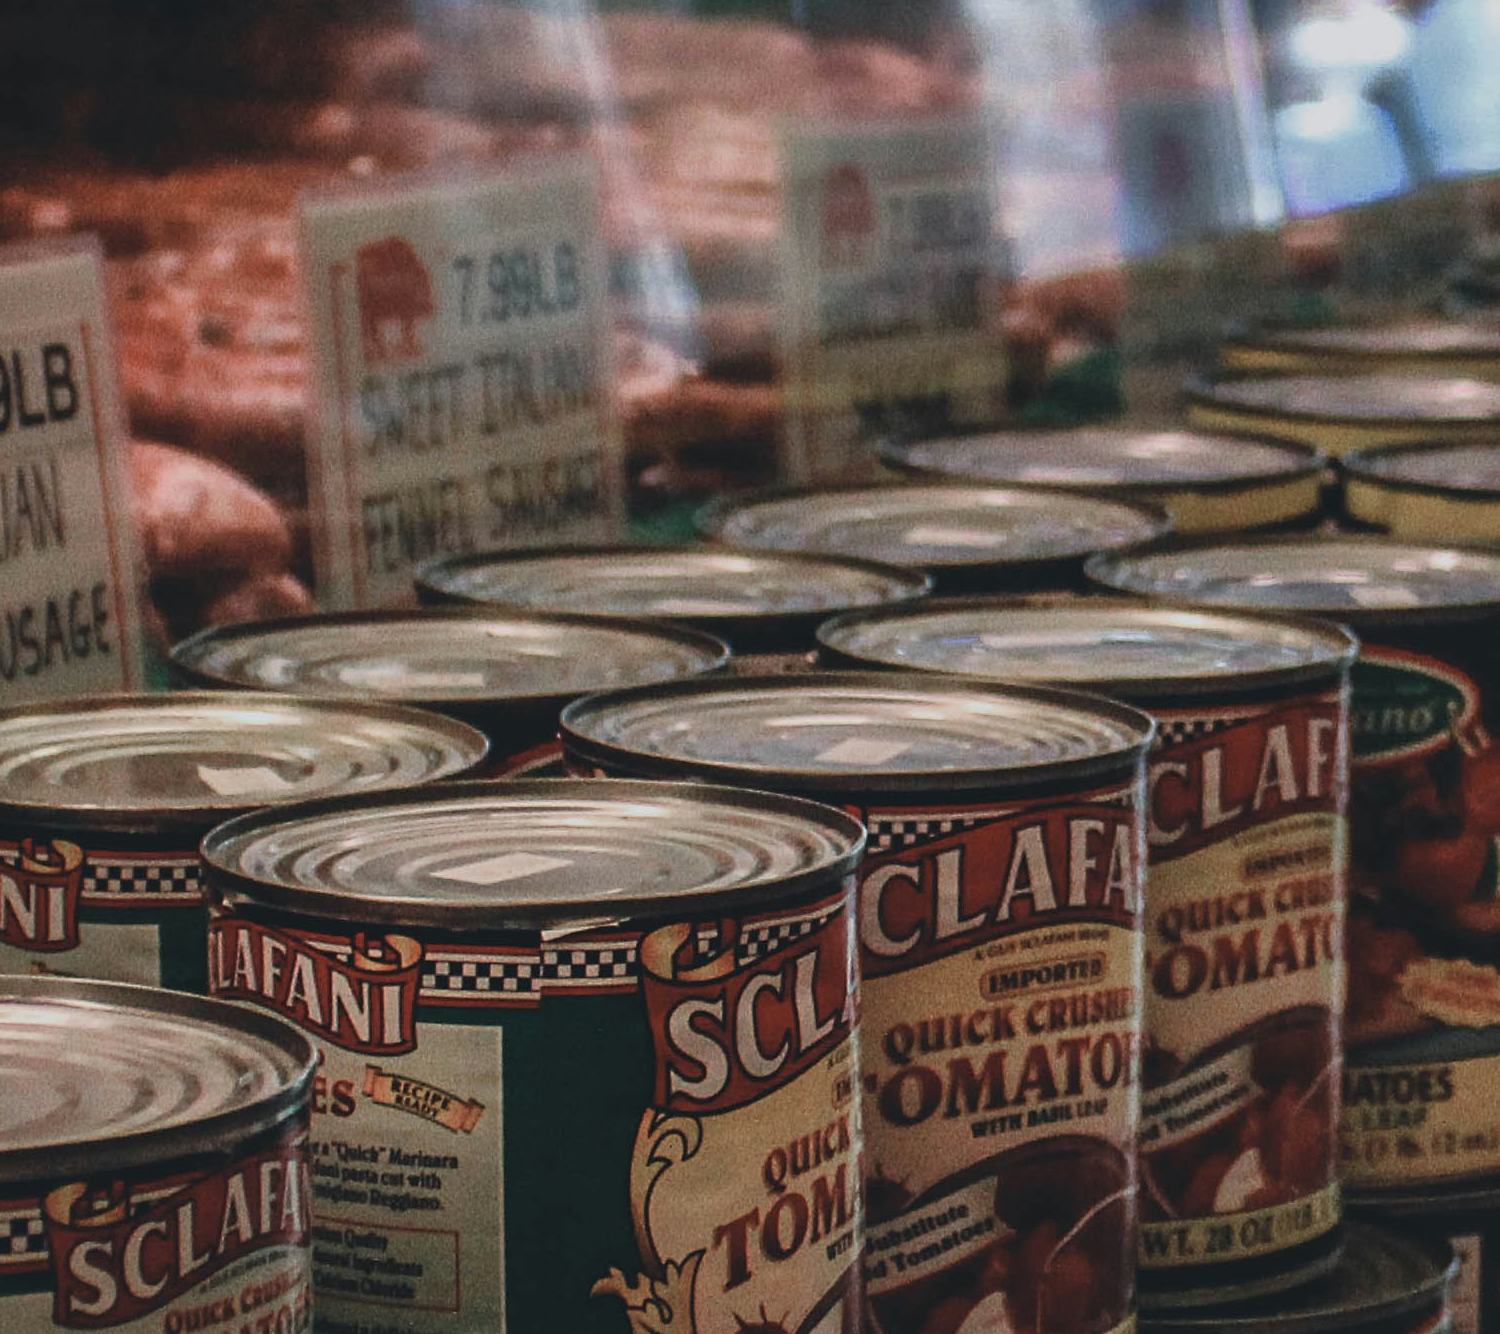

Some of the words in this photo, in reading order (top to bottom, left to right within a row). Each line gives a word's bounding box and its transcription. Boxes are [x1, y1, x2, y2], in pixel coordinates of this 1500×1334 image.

[455, 243, 580, 325] 7.99LB
[1148, 719, 1345, 848] CLAF
[1159, 888, 1267, 943] QUICK
[990, 959, 1102, 992] IMPORTED
[1145, 914, 1340, 998] OMAT
[208, 928, 403, 1047] LAFANI
[668, 950, 856, 1102] SCL
[885, 1005, 1014, 1063] QUICK
[308, 1075, 357, 1119] ES
[391, 1079, 452, 1111] RECIPE
[395, 1095, 440, 1120] READY
[864, 1033, 1140, 1125] OMATO
[972, 1112, 1022, 1138] WITH
[1027, 1104, 1073, 1127] BASIL
[389, 1147, 460, 1170] Marinara
[407, 1172, 443, 1191] with
[68, 1151, 310, 1318] SCLAFA
[713, 1164, 860, 1293] TOM
[890, 1216, 995, 1272] Tomatoes
